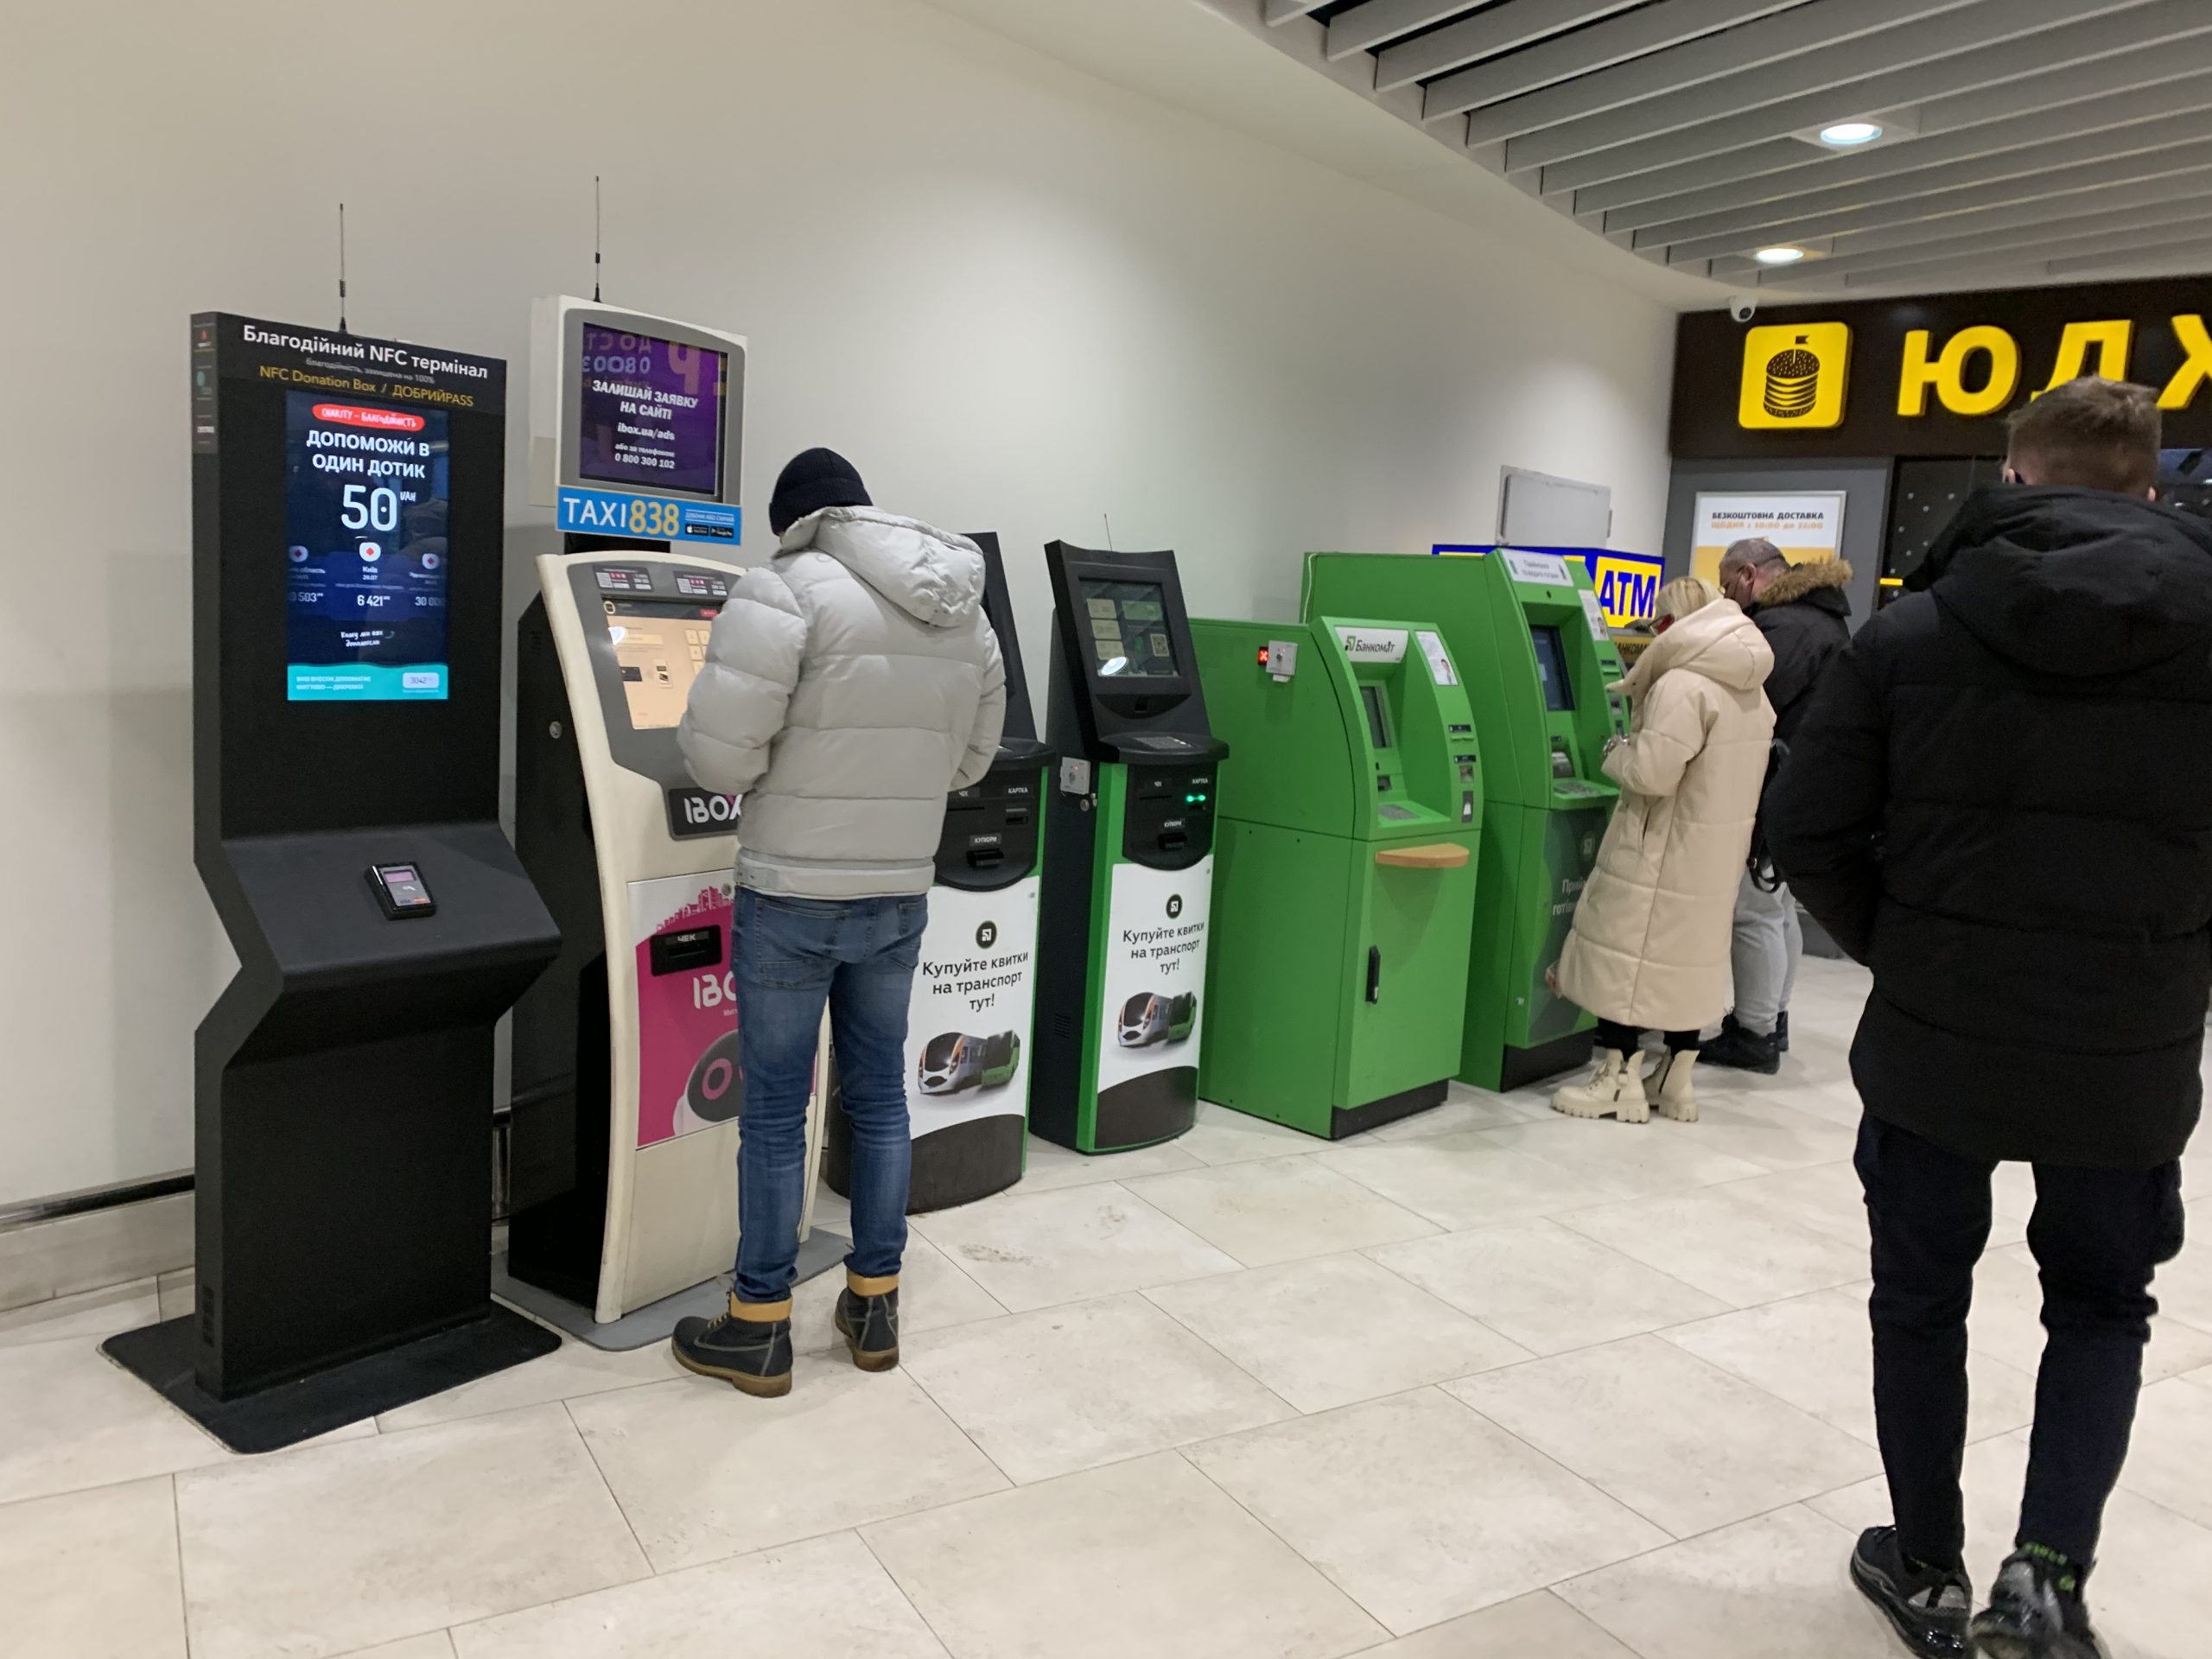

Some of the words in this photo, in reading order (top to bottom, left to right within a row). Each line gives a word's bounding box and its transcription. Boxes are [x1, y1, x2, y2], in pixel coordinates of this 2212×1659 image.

[243, 325, 365, 359] Благодійний
[369, 345, 408, 366] NFC
[410, 354, 488, 379] термінал
[259, 365, 289, 381] NFC
[292, 370, 350, 389] Donation
[353, 378, 377, 393] Box
[392, 384, 474, 407] ДОБРИЙPASS
[415, 374, 435, 385] 100%
[592, 379, 653, 402] ЗАЛИШАЙ
[654, 391, 698, 409] ЗАЯВКУ
[620, 401, 637, 415] НА
[639, 404, 673, 420] САЙТІ
[306, 429, 415, 455] ДОПОМОЖИ
[418, 442, 429, 456] В
[617, 422, 676, 441] ibox.ua/ads
[312, 454, 364, 474] ОДИН
[367, 460, 425, 479] ДОТИК
[614, 453, 621, 461] 0
[622, 453, 639, 465] 800
[640, 456, 658, 467] 300
[658, 458, 676, 469] 102
[341, 484, 397, 531] 50
[400, 492, 416, 501] UAH
[1776, 512, 1825, 520] ДОСТАВКА
[357, 594, 365, 607] 6
[366, 595, 384, 607] 421
[1599, 569, 1656, 619] ATM
[1355, 639, 1395, 653] Банкомат
[683, 793, 743, 824] IBOX
[677, 933, 696, 943] ЧЕК
[1123, 927, 1175, 944] Купуйте
[1177, 921, 1205, 938] квитки
[1130, 948, 1147, 959] на
[1150, 938, 1200, 960] транспорт
[922, 958, 988, 978] Купуйте
[991, 951, 1029, 970] квитки
[1160, 958, 1180, 976] тут!
[693, 970, 737, 1009] IBO
[932, 981, 952, 995] на
[957, 970, 1022, 995] транспорт
[969, 994, 995, 1013] тут!
